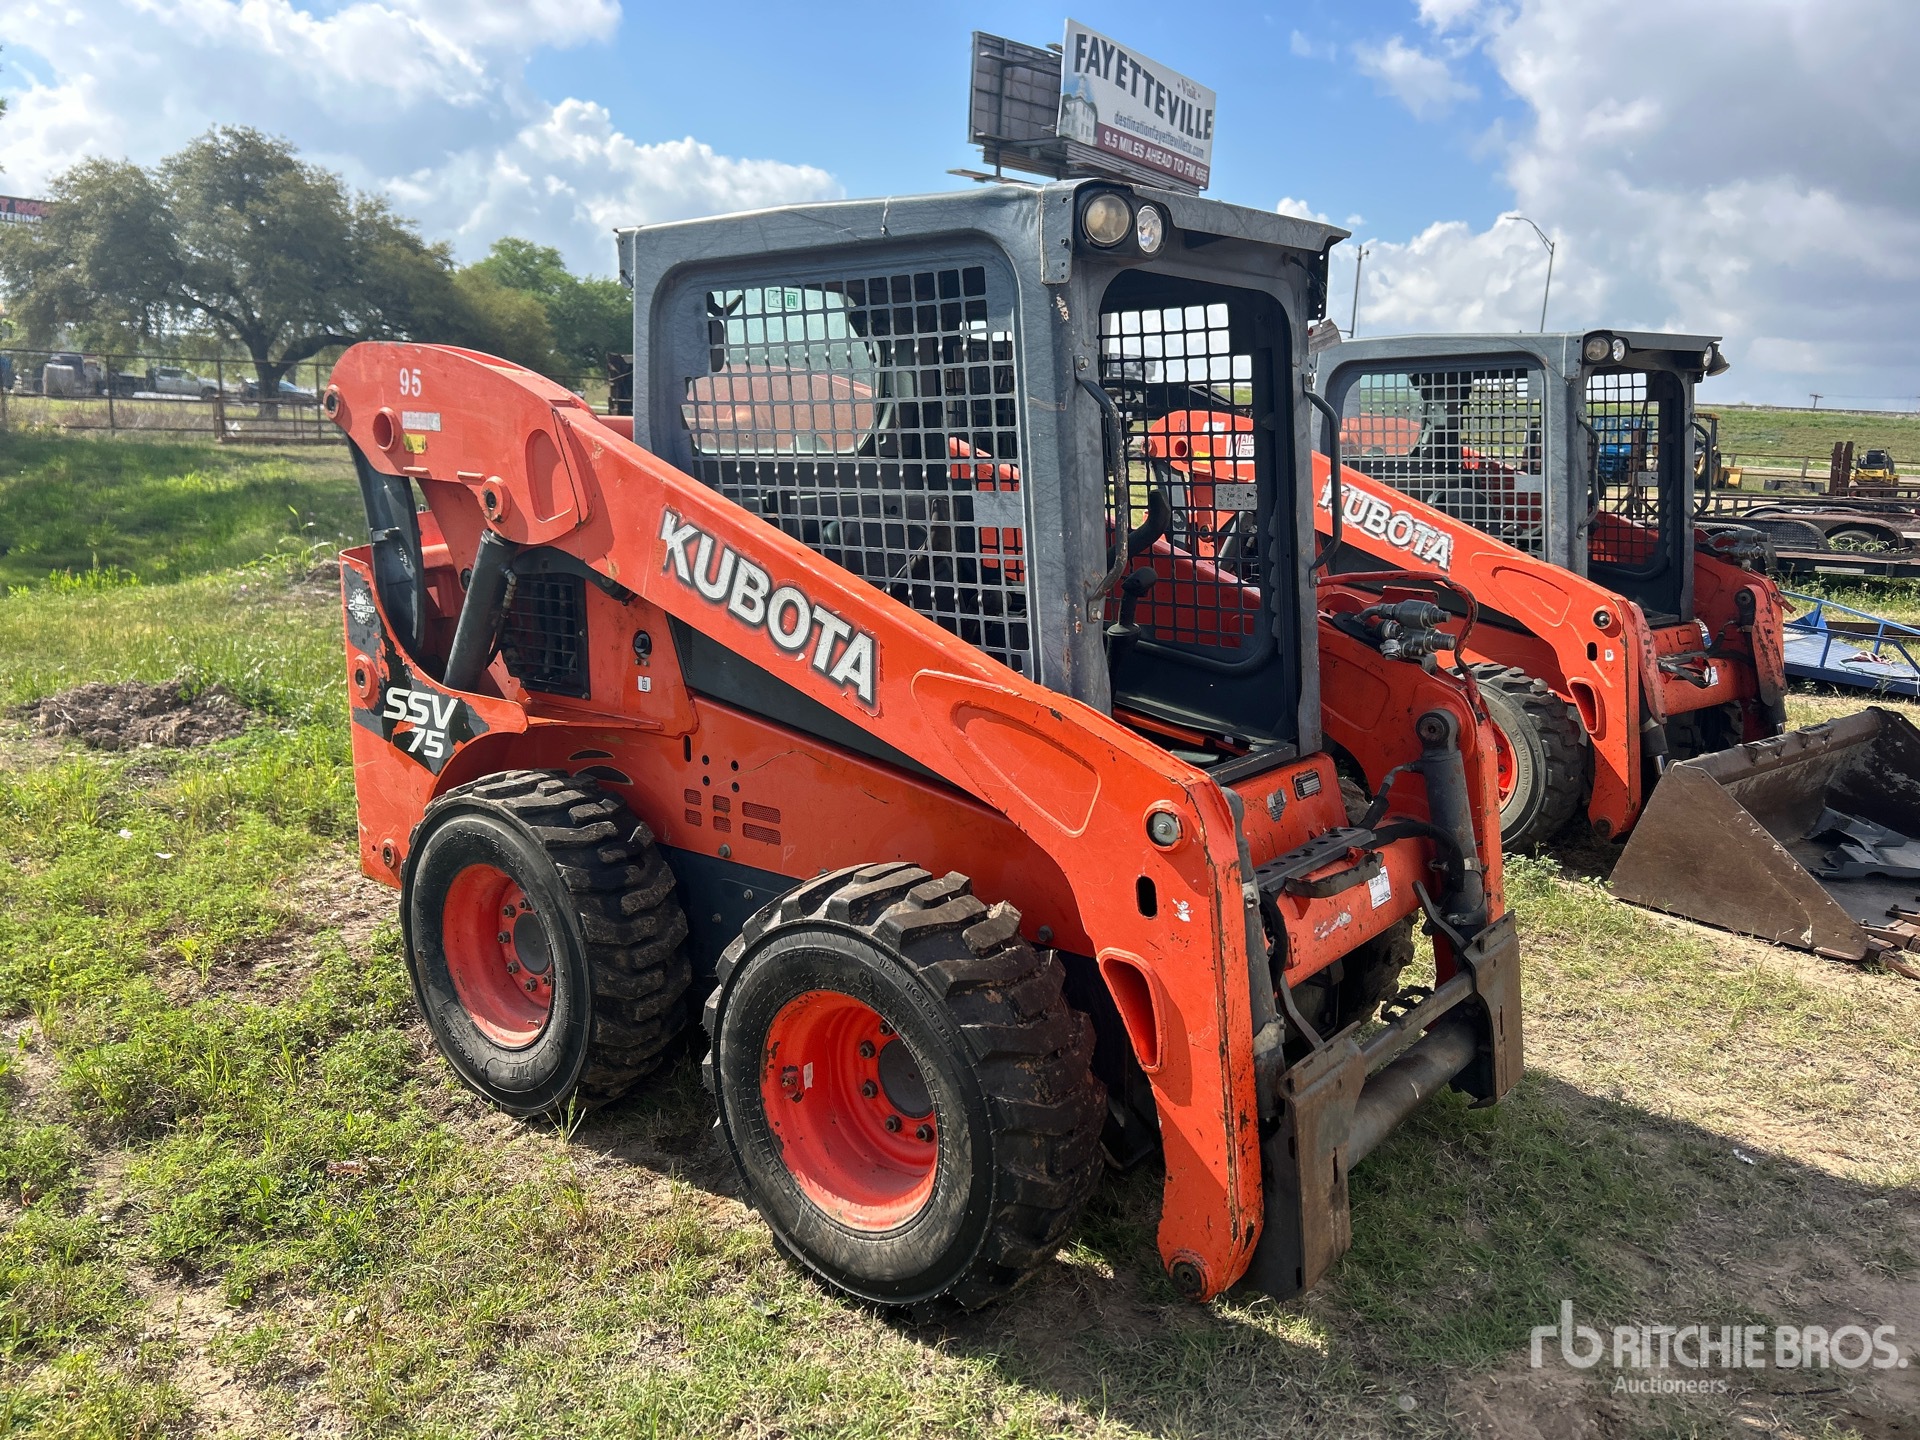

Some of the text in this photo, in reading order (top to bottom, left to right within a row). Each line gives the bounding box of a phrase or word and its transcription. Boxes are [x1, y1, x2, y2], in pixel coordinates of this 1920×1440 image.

[1074, 33, 1213, 140] FAYETTEVILLE
[1104, 131, 1118, 149] 9.5
[1119, 136, 1145, 159] MILES
[1145, 147, 1173, 169] AHEAD
[1173, 157, 1184, 173] TO
[1184, 162, 1196, 178] FM
[400, 367, 421, 397] 95
[1317, 473, 1451, 571] KUBOTA
[661, 510, 873, 705] KUBOTA
[383, 687, 459, 731] SSV
[407, 727, 446, 760] 75
